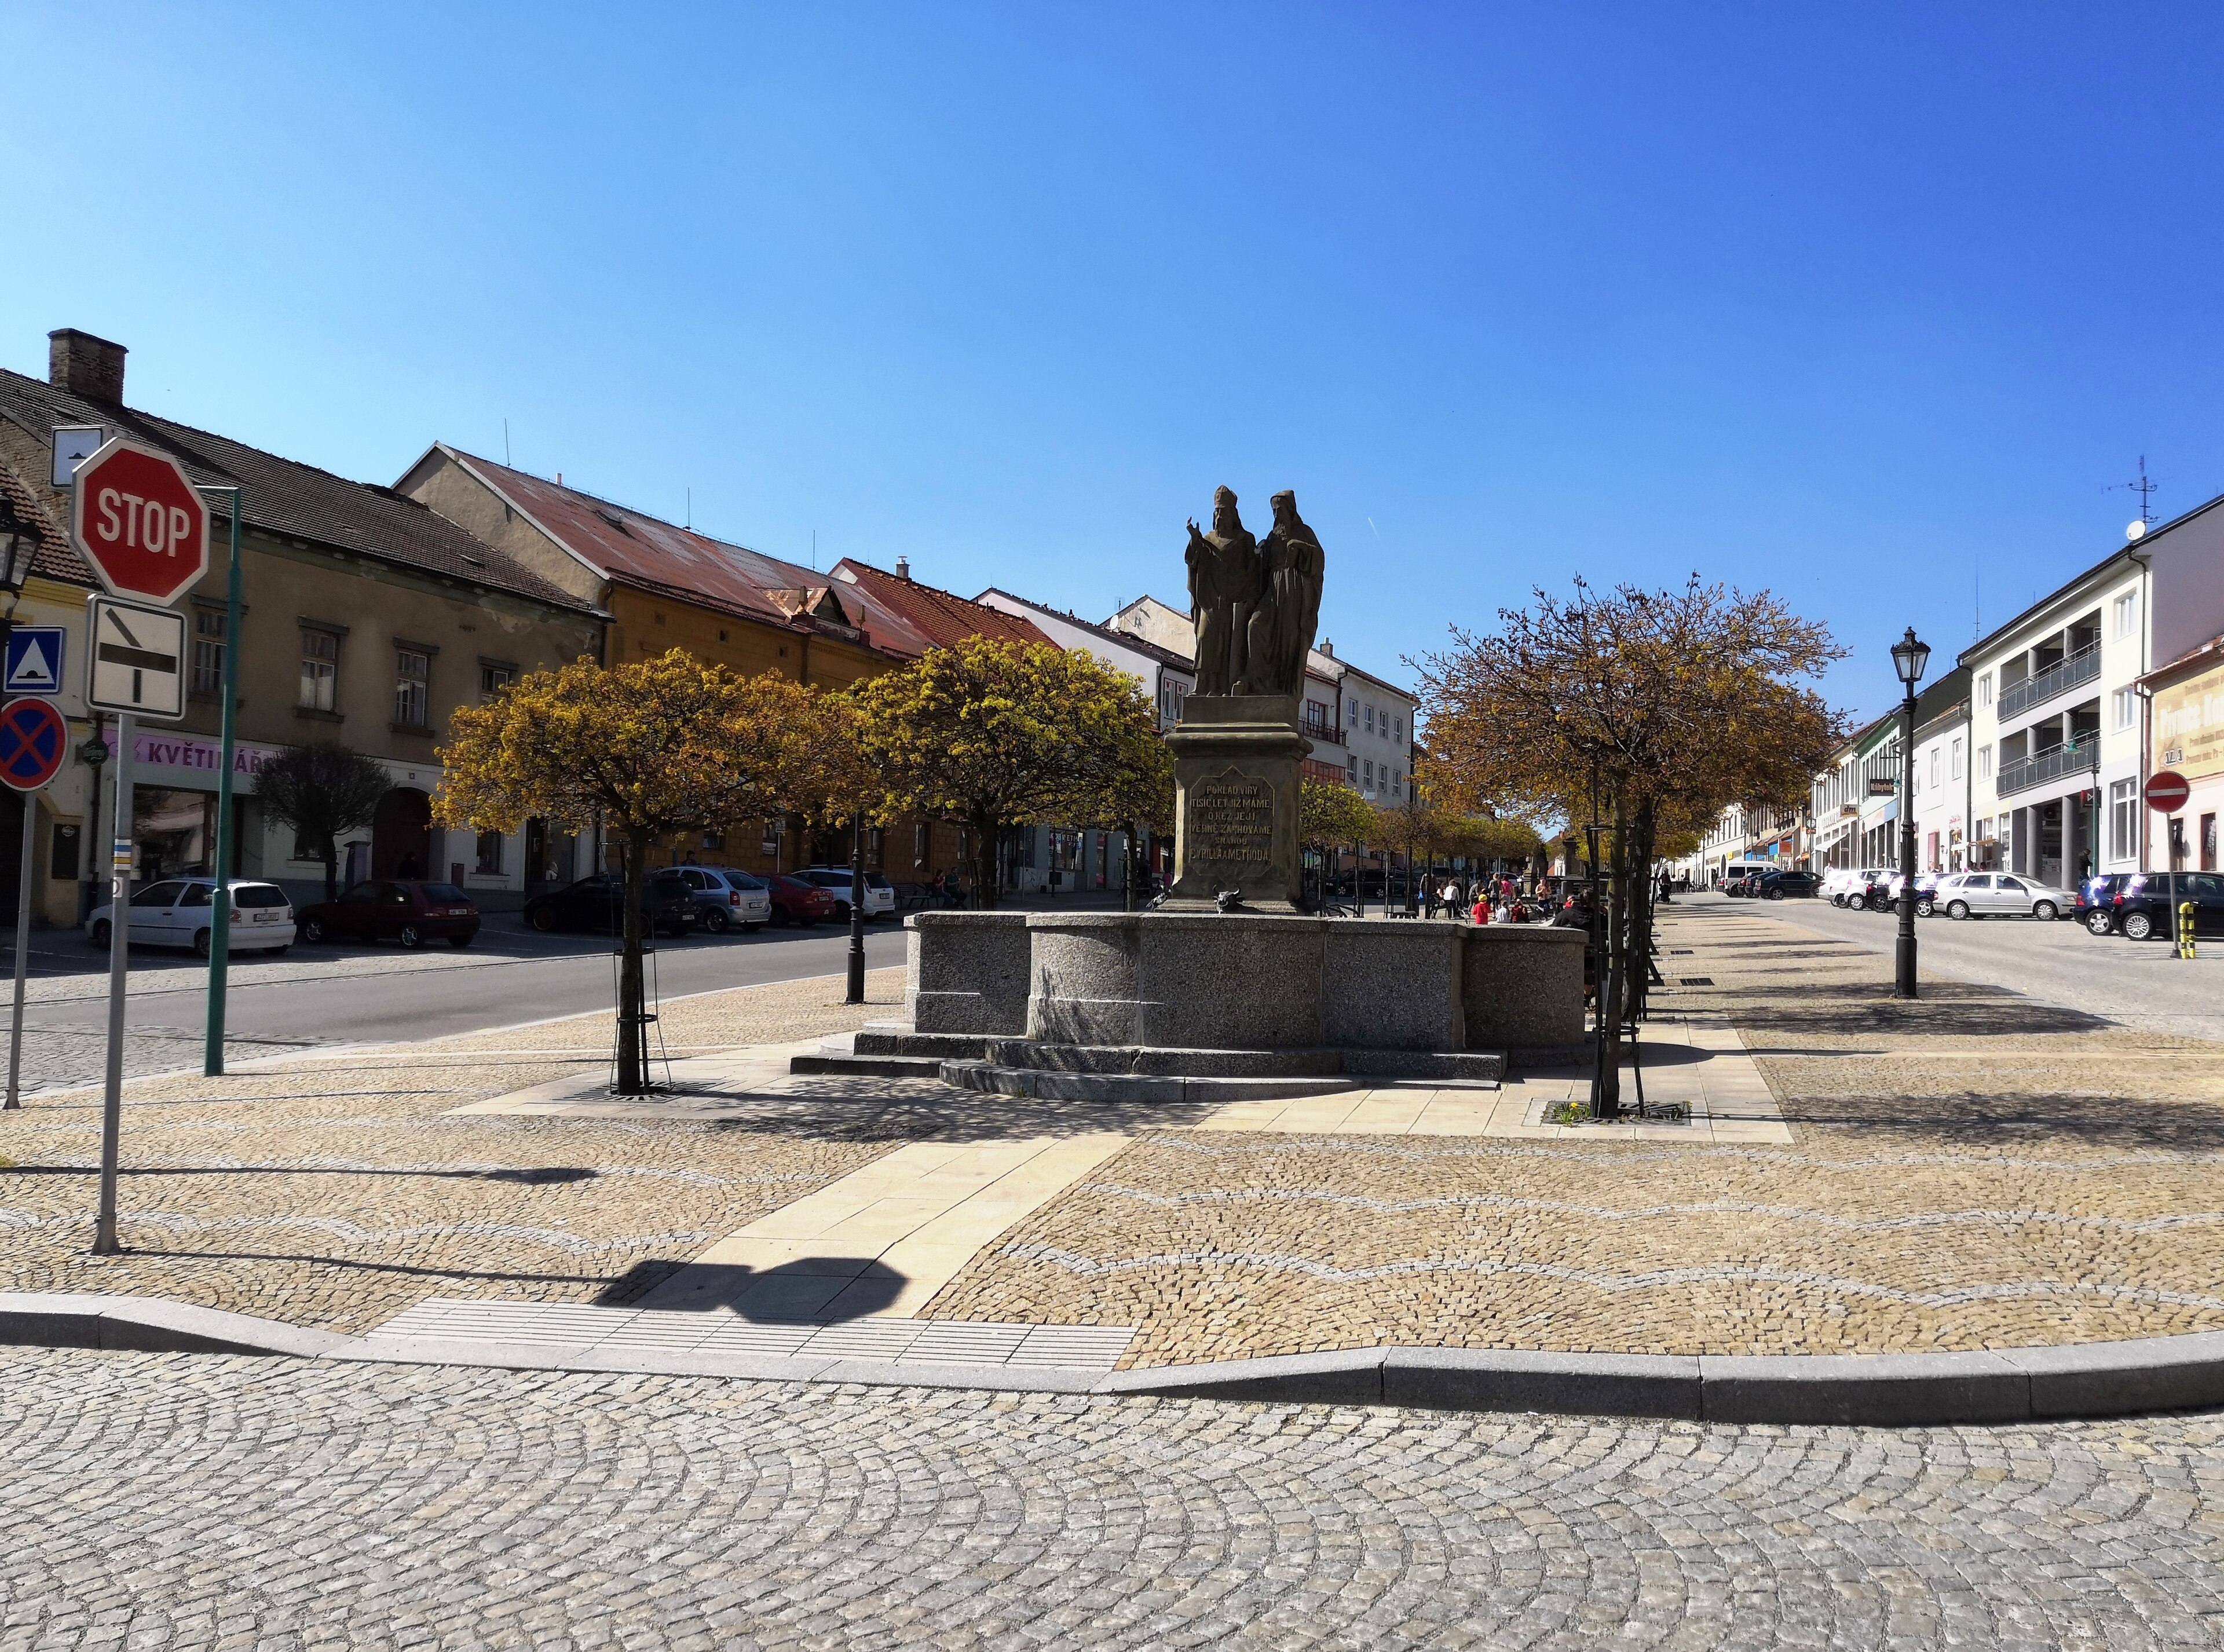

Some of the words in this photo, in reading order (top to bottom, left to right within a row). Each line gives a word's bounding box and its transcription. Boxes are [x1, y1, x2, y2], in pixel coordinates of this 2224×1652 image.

[97, 488, 191, 557] STOP
[1206, 785, 1238, 795] POKLAD
[1213, 798, 1227, 808] LET
